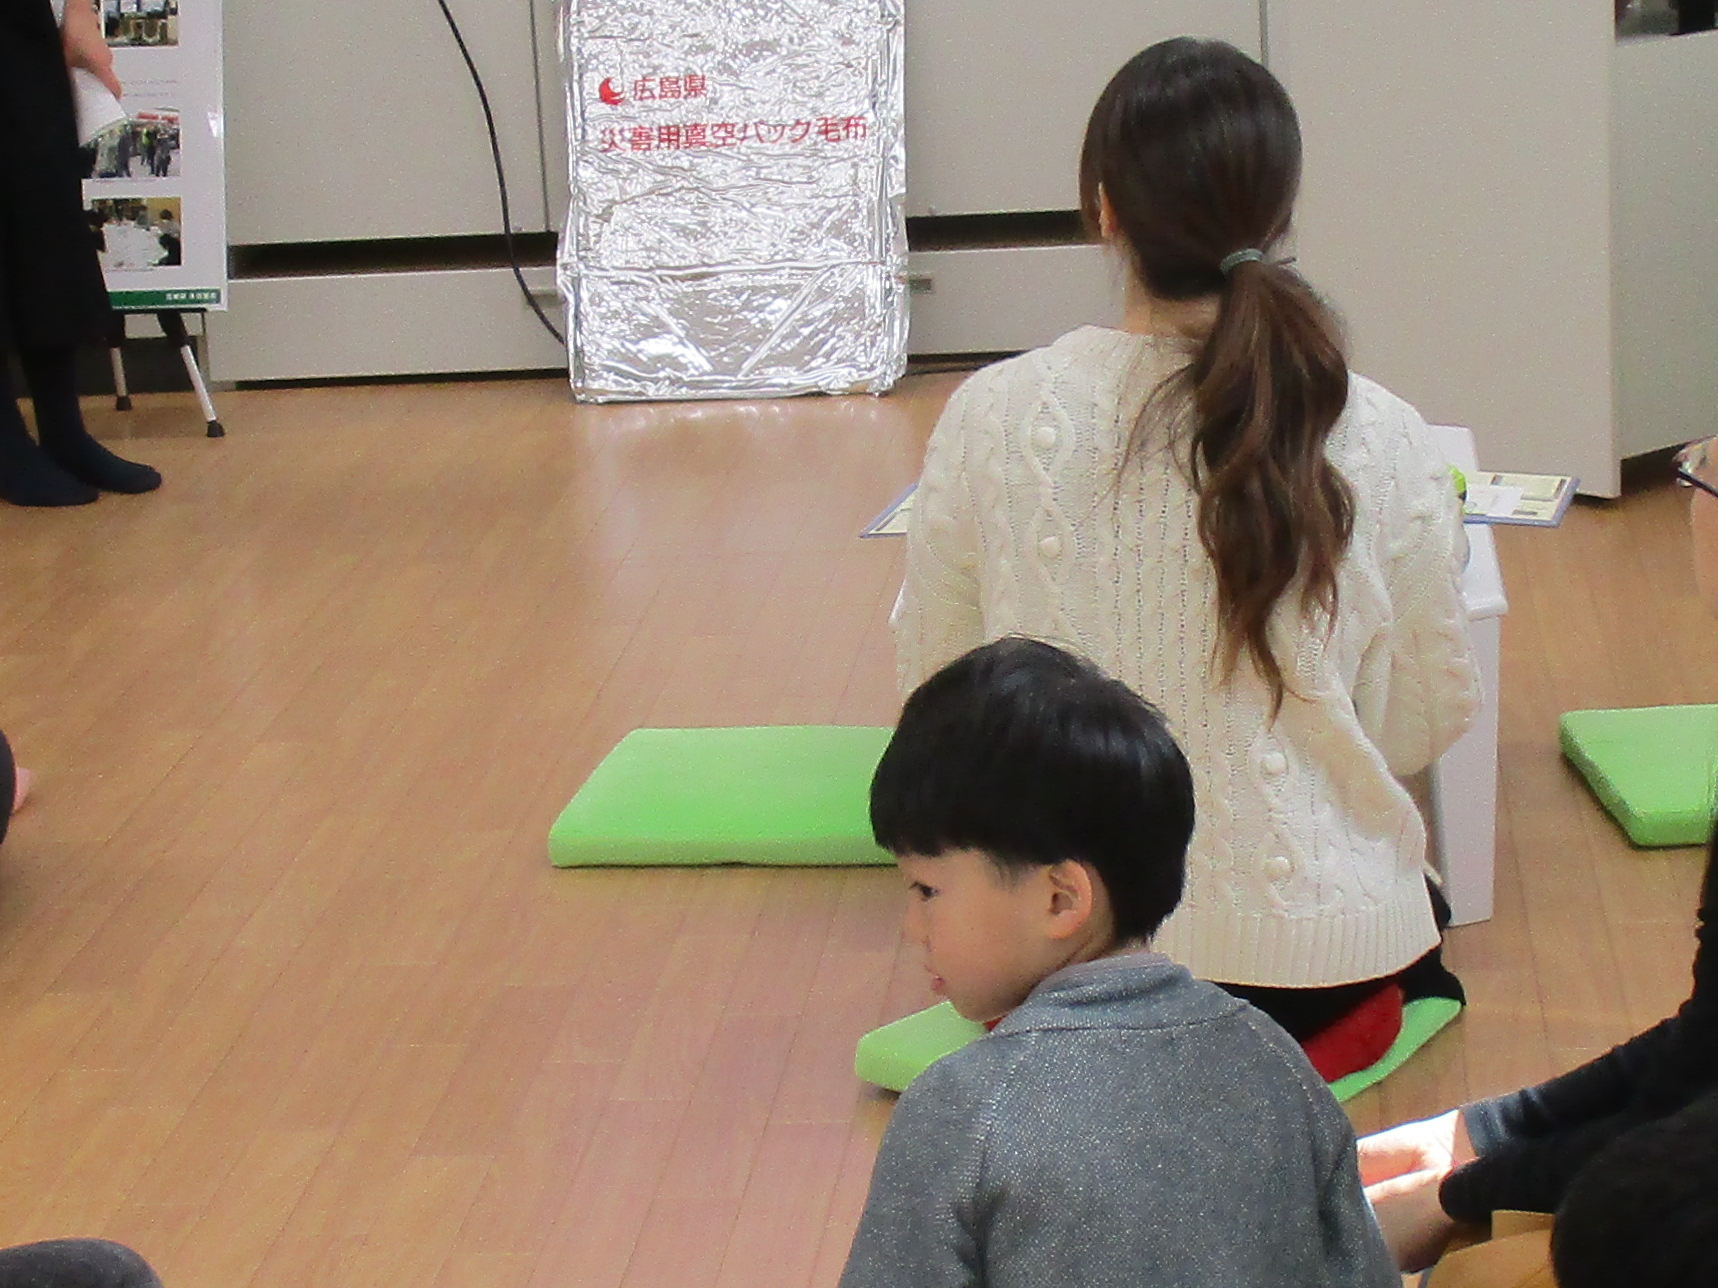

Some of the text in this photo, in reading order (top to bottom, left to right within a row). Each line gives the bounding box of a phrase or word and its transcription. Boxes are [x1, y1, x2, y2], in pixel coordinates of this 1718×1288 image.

[633, 74, 707, 101] 広島県
[599, 115, 868, 153] 災害用真空パック毛布
